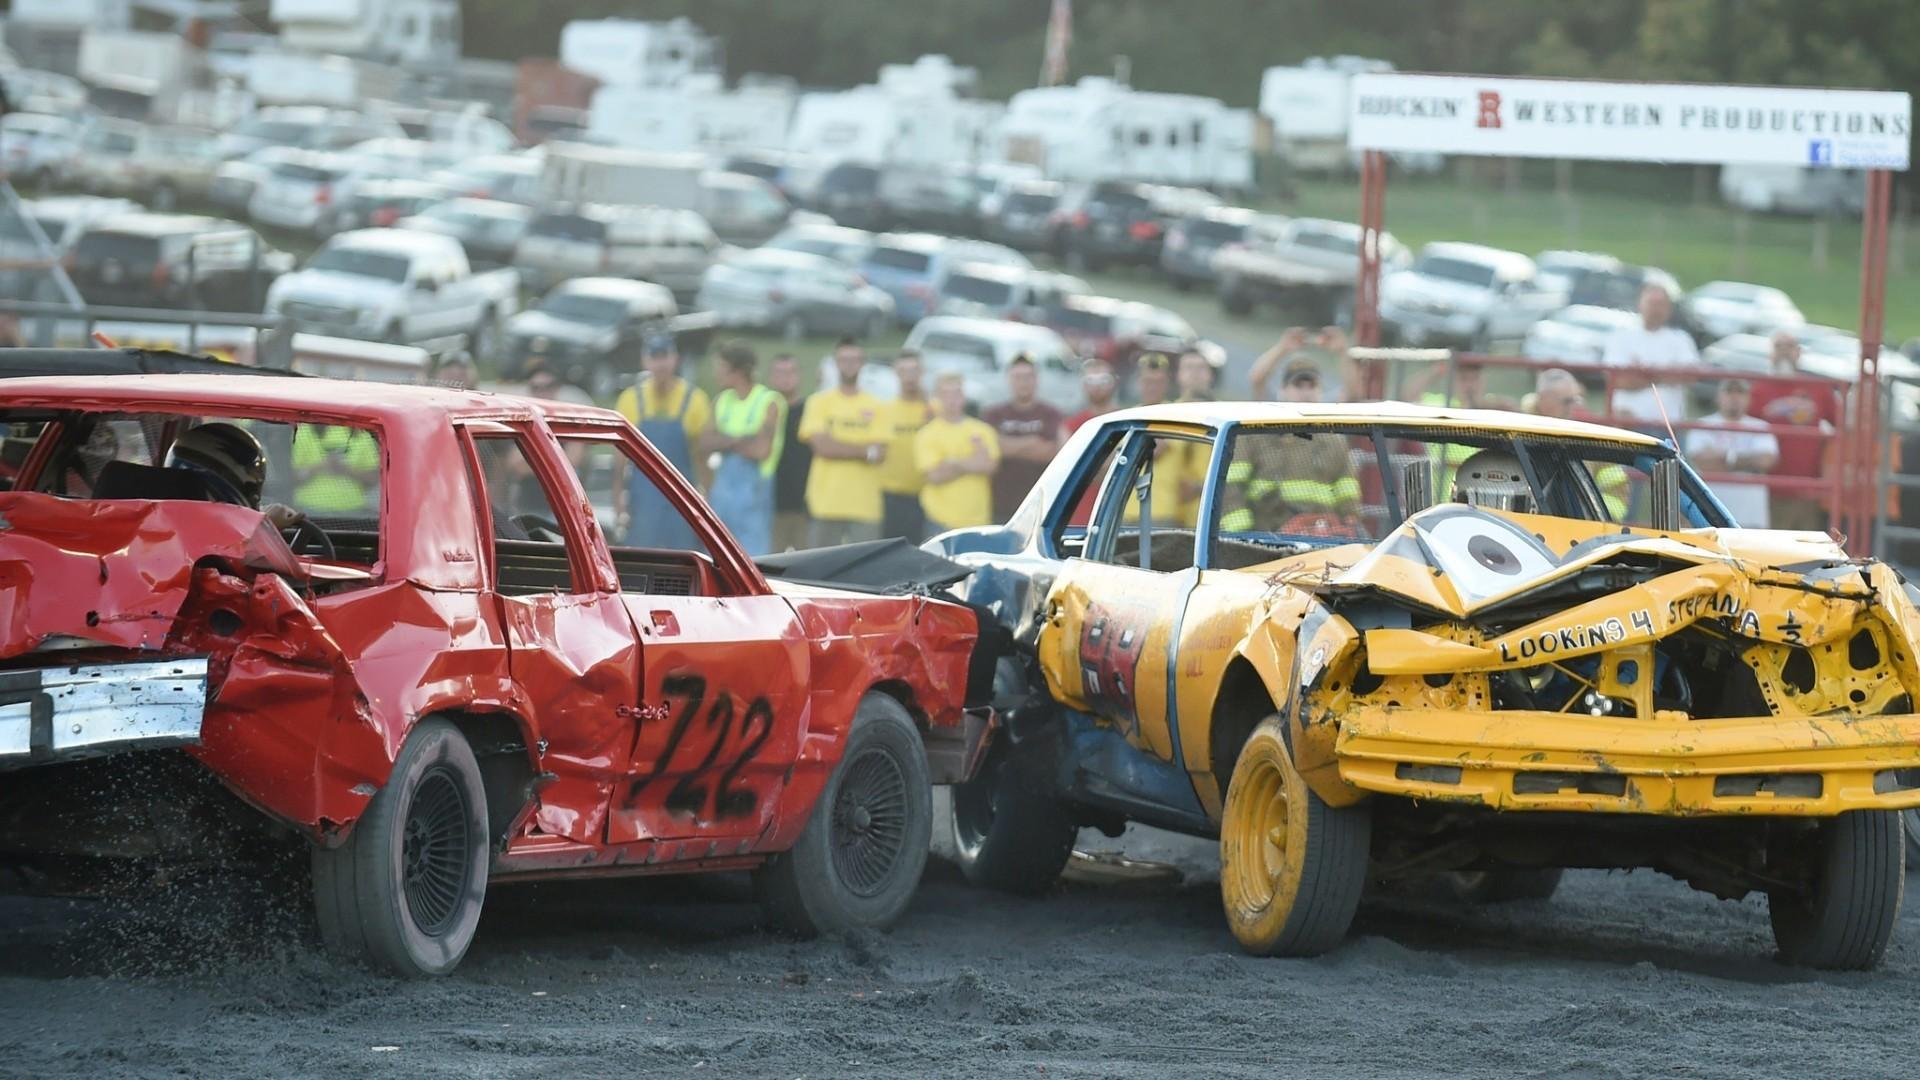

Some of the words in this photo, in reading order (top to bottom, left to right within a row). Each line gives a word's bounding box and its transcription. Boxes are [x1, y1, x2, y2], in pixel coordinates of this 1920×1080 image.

[1514, 100, 1662, 126] WESTERN
[1679, 104, 1906, 135] PRODUCTIONS
[1630, 608, 1655, 636] 4
